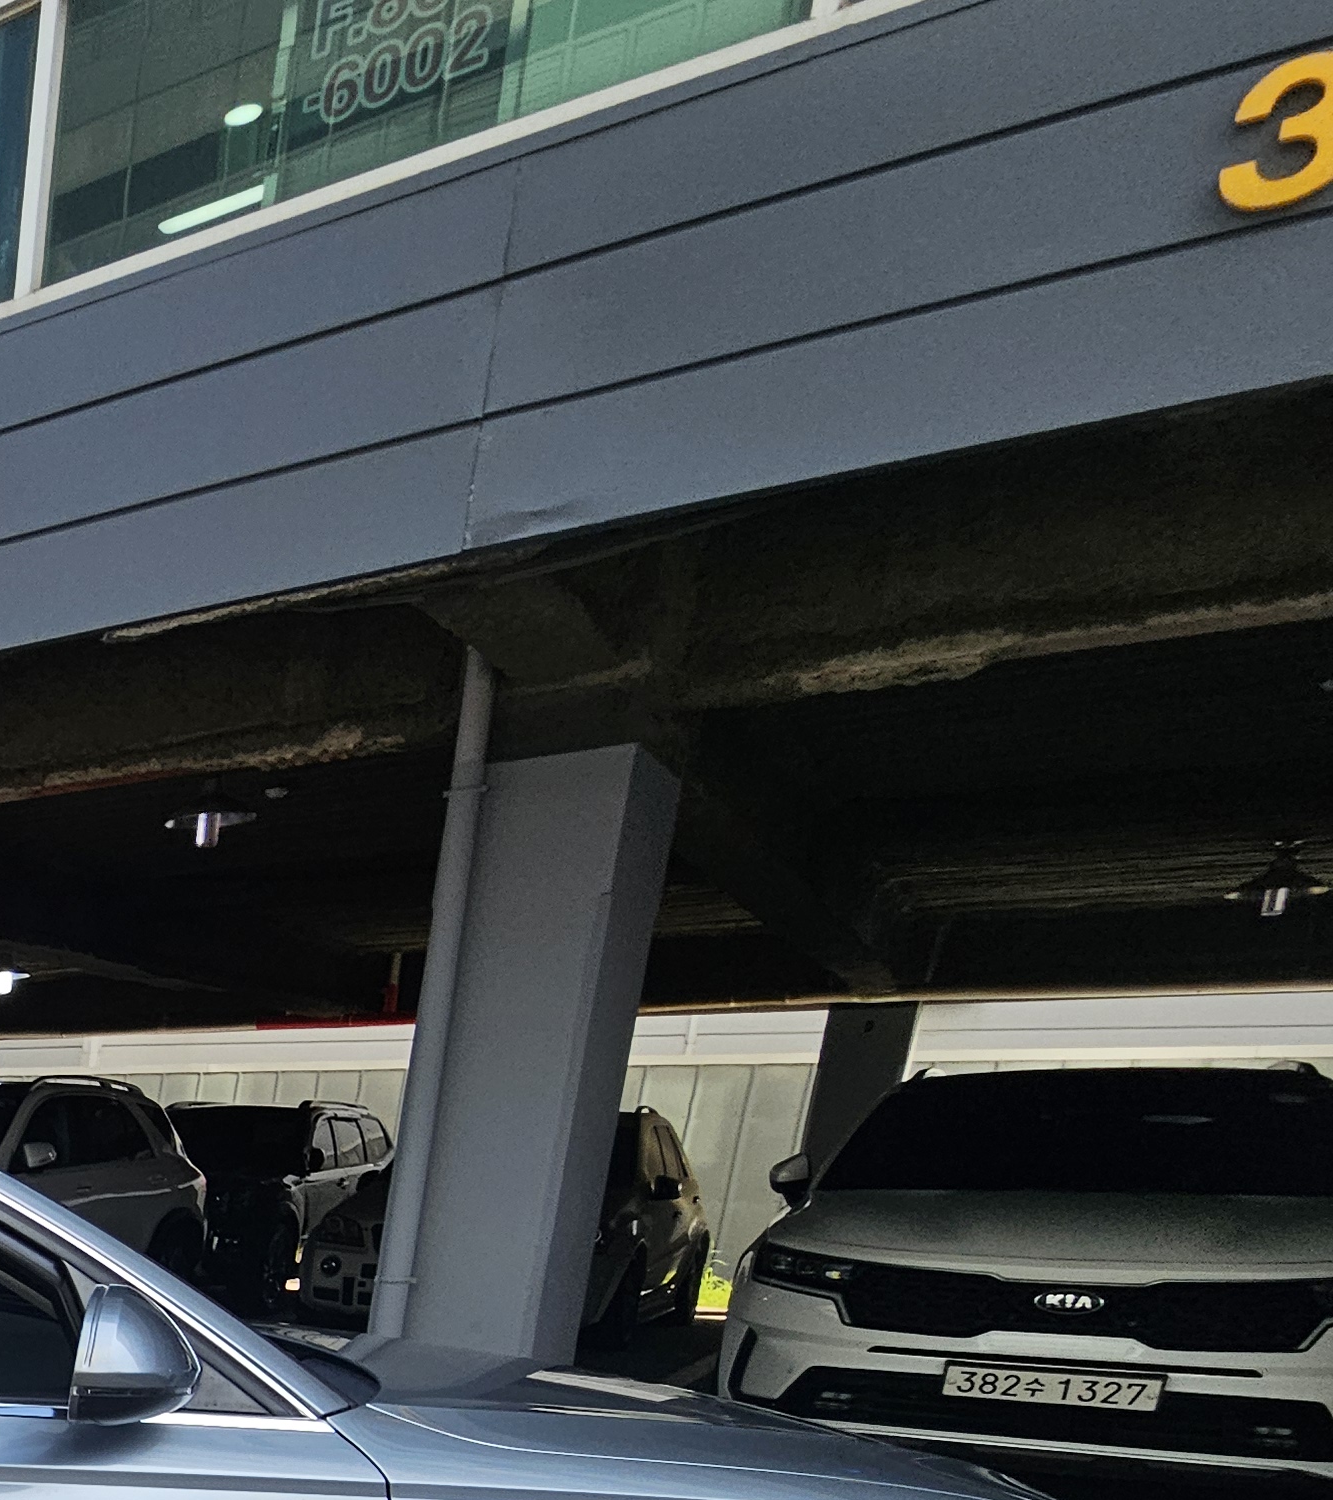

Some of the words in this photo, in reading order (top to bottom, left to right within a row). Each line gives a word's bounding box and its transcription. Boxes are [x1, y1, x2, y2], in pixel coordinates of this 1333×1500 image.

[1218, 50, 1333, 213] 3
[1044, 1292, 1093, 1310] KIA
[956, 1371, 1046, 1398] 382수
[1057, 1378, 1148, 1406] 1327
